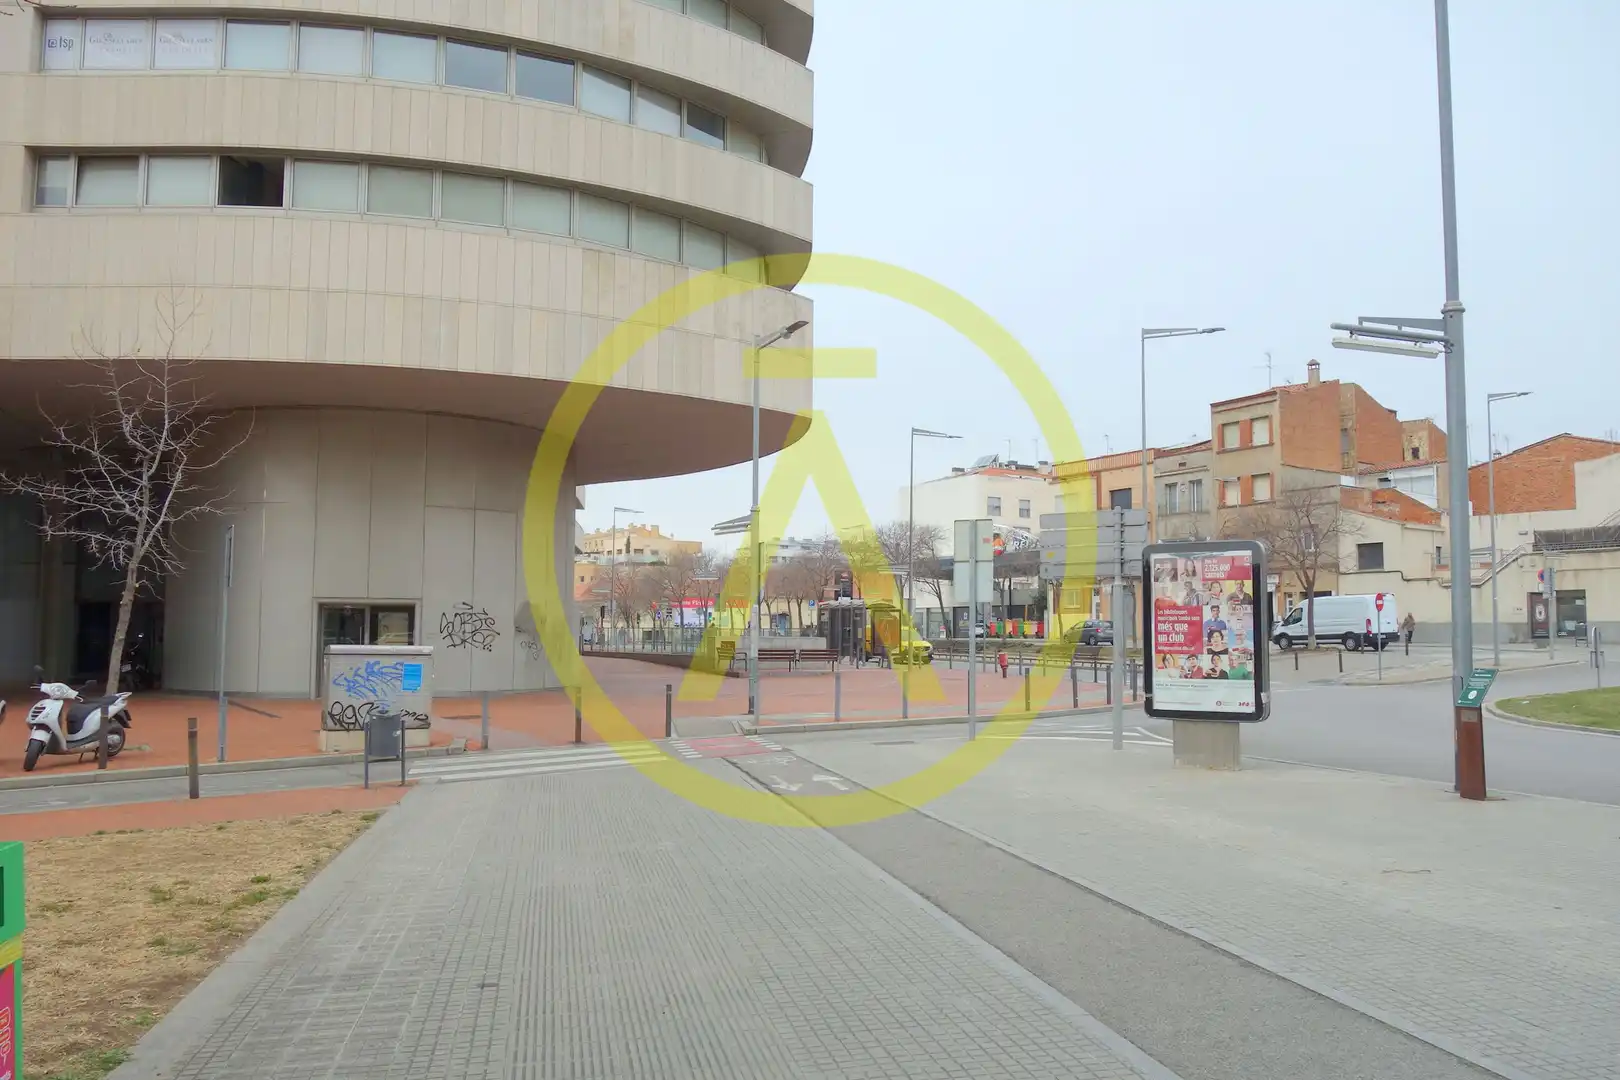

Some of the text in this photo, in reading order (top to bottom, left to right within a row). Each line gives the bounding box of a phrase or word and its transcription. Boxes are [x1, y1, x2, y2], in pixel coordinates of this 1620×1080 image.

[1157, 621, 1189, 632] més que
[1157, 632, 1185, 642] un club
